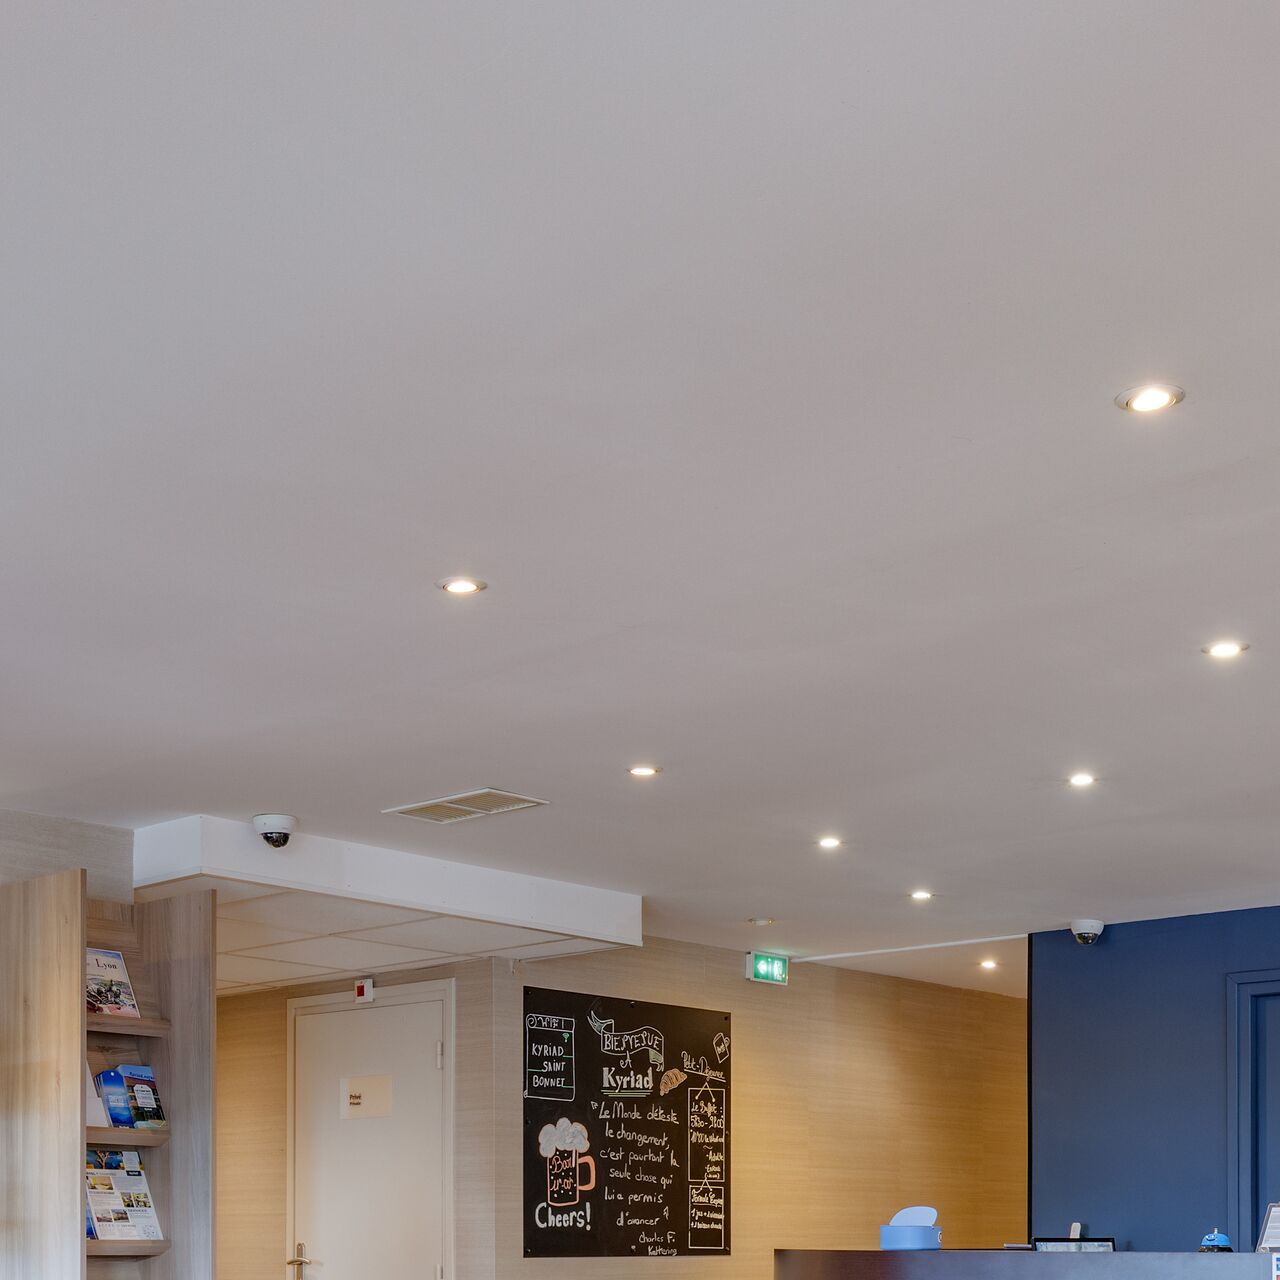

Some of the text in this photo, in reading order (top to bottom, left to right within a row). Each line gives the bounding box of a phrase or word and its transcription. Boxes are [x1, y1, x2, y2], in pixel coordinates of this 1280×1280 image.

[95, 958, 117, 970] Lyon
[533, 1075, 565, 1087] BONNET
[602, 1067, 653, 1092] Kyriad
[612, 1101, 642, 1119] Monde
[605, 1121, 614, 1137] le
[661, 1175, 672, 1189] qui
[628, 1192, 664, 1205] permis
[535, 1202, 591, 1231] Cheers!
